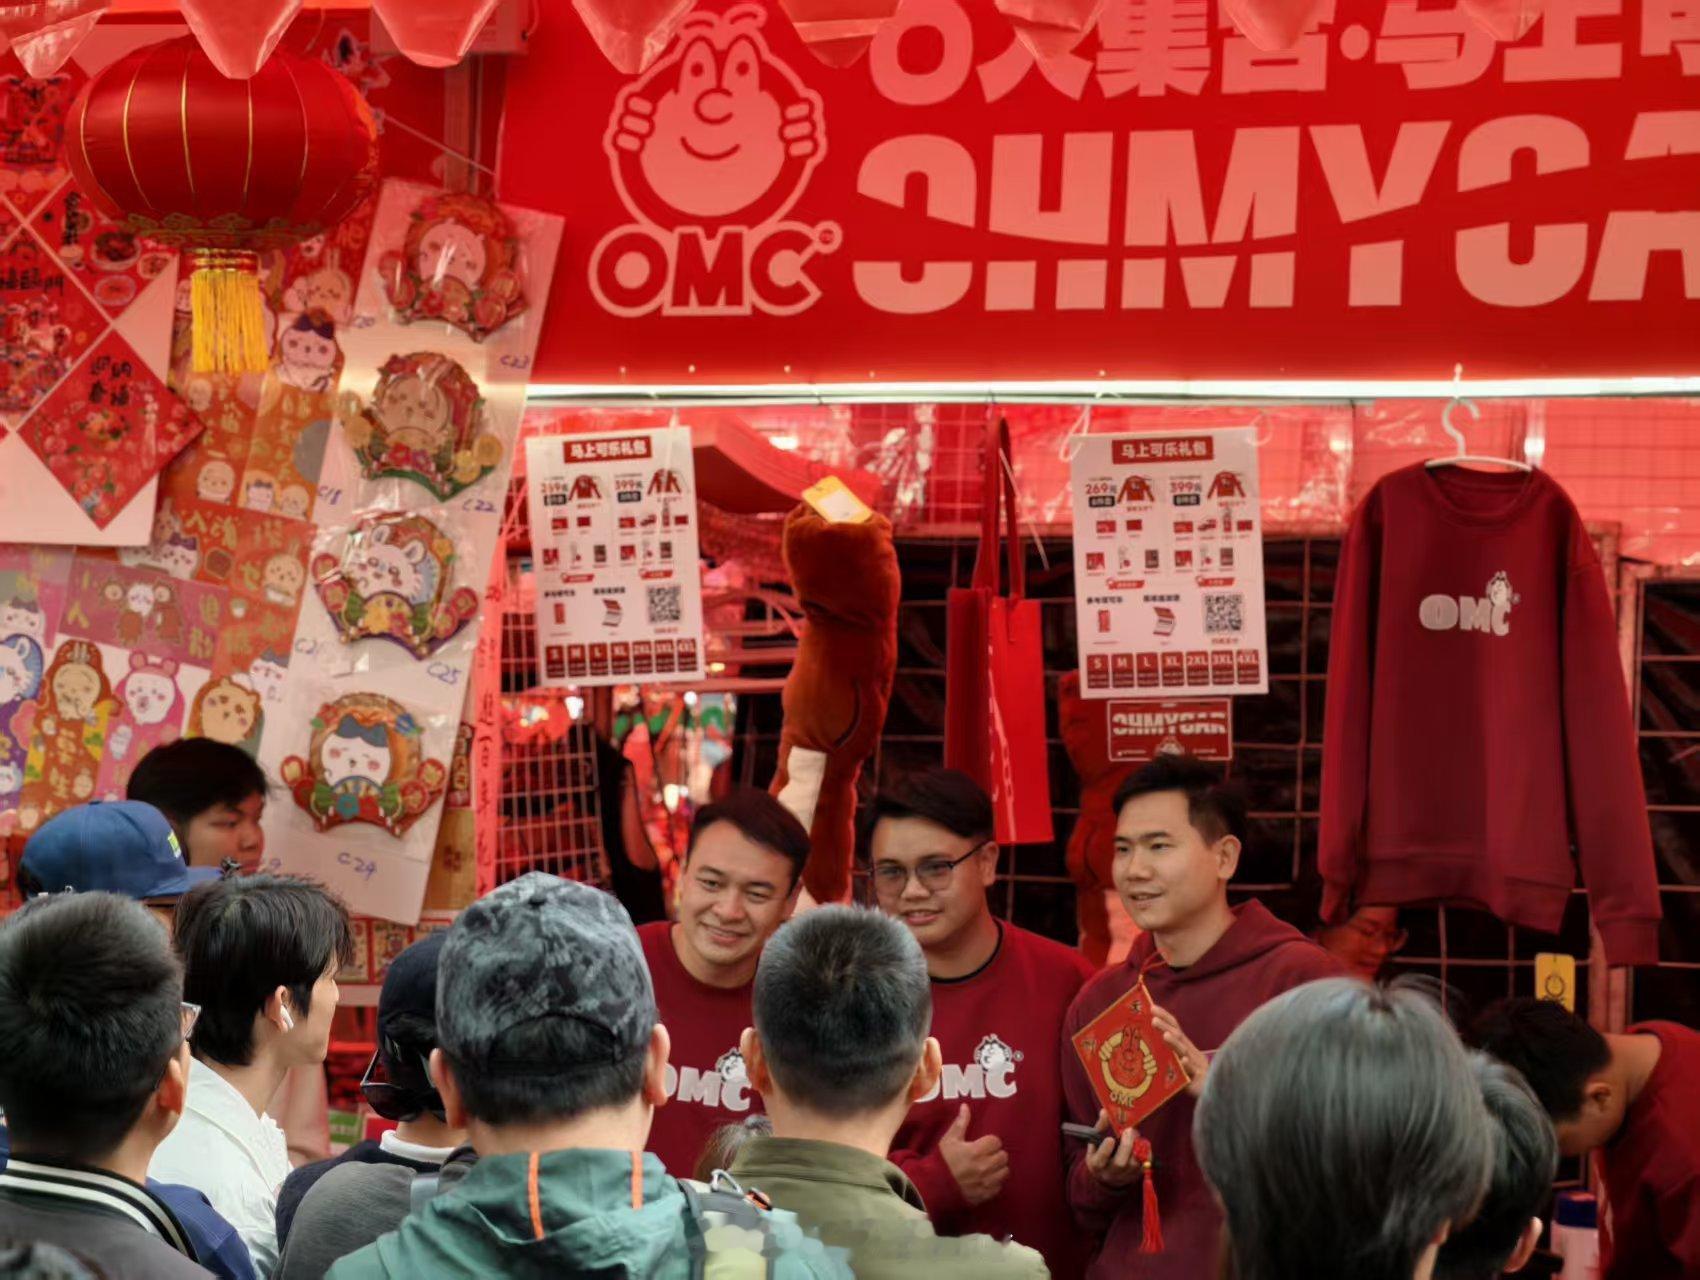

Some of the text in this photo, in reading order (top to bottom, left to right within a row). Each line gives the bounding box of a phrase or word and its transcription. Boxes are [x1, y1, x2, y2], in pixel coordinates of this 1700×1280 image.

[589, 223, 826, 317] OMC
[1121, 441, 1207, 458] 马上可乐礼包
[1419, 594, 1512, 636] OMC
[1094, 652, 1258, 669] S M L XL 2XL 3XL 4XL
[427, 661, 461, 685] C25
